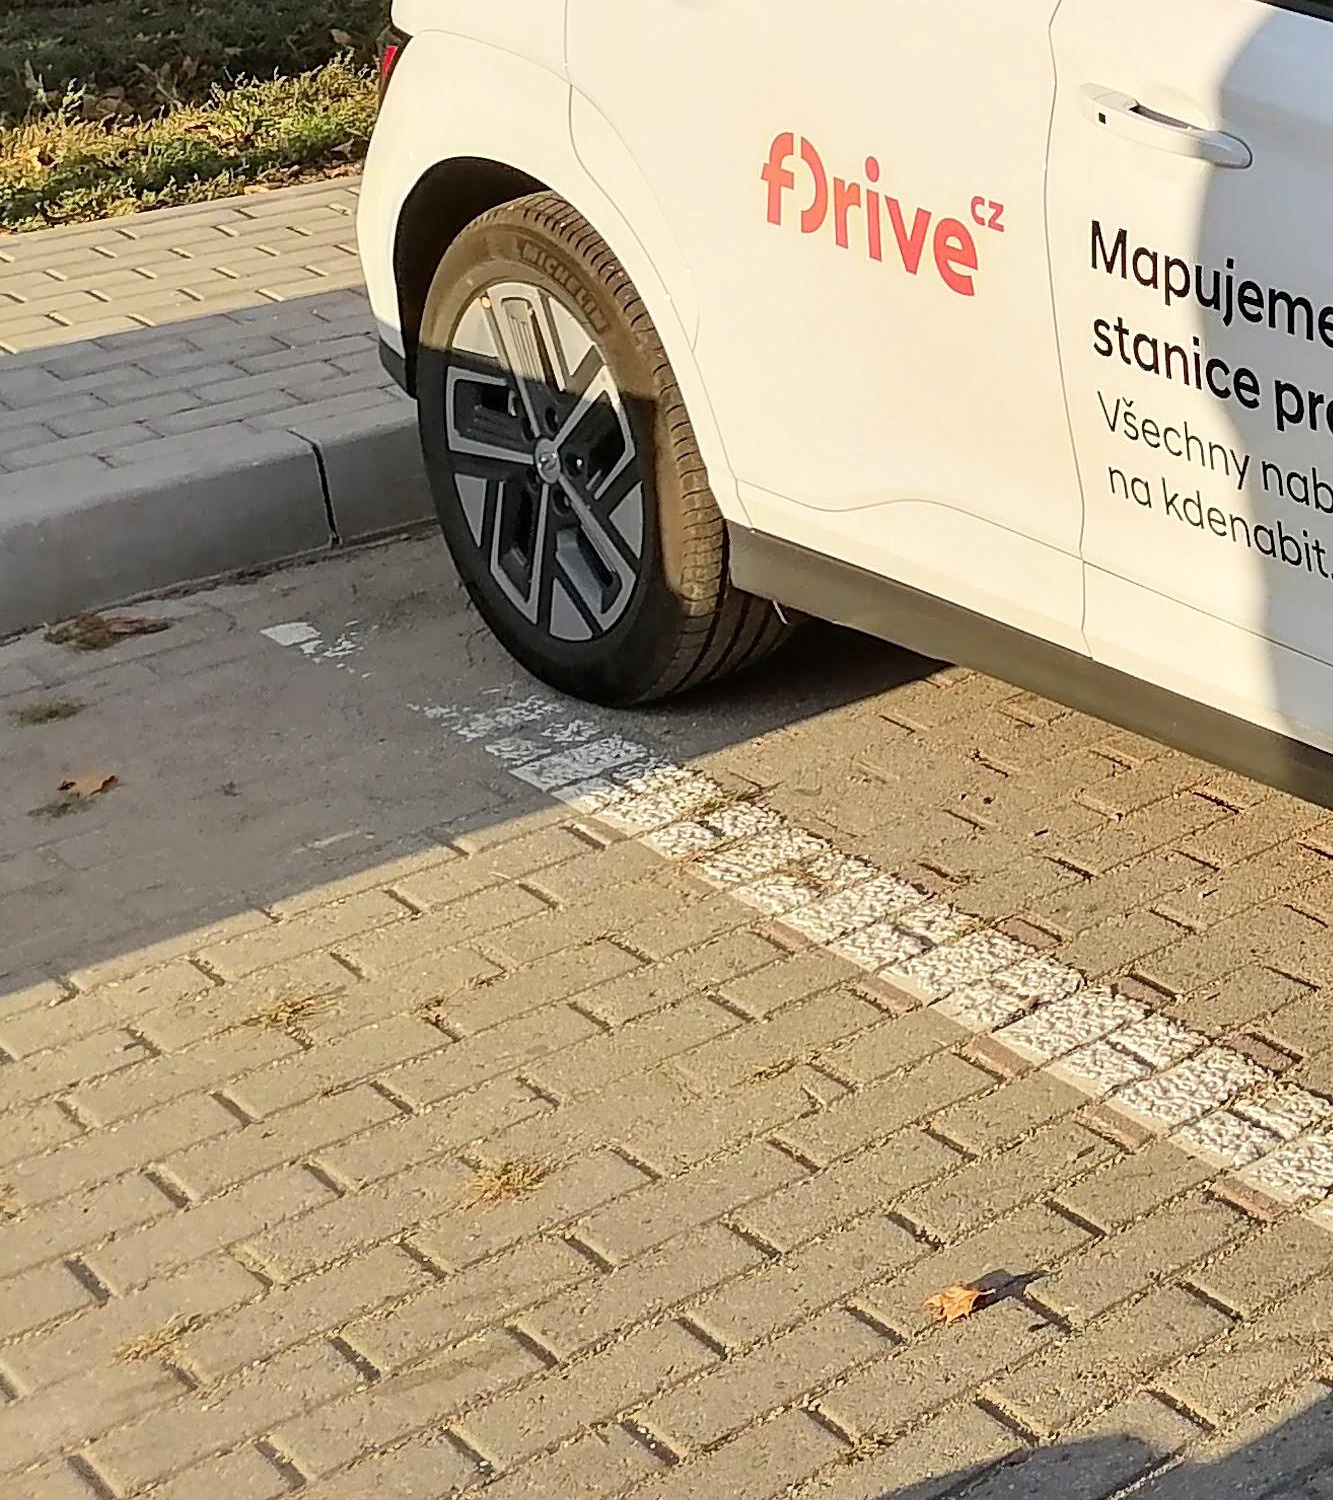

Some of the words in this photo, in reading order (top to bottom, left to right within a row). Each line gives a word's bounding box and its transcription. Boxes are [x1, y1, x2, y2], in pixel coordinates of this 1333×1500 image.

[521, 240, 613, 333] MICHELIN
[1093, 316, 1260, 410] stanice
[1097, 389, 1250, 490] Všechny
[1108, 465, 1152, 509] na
